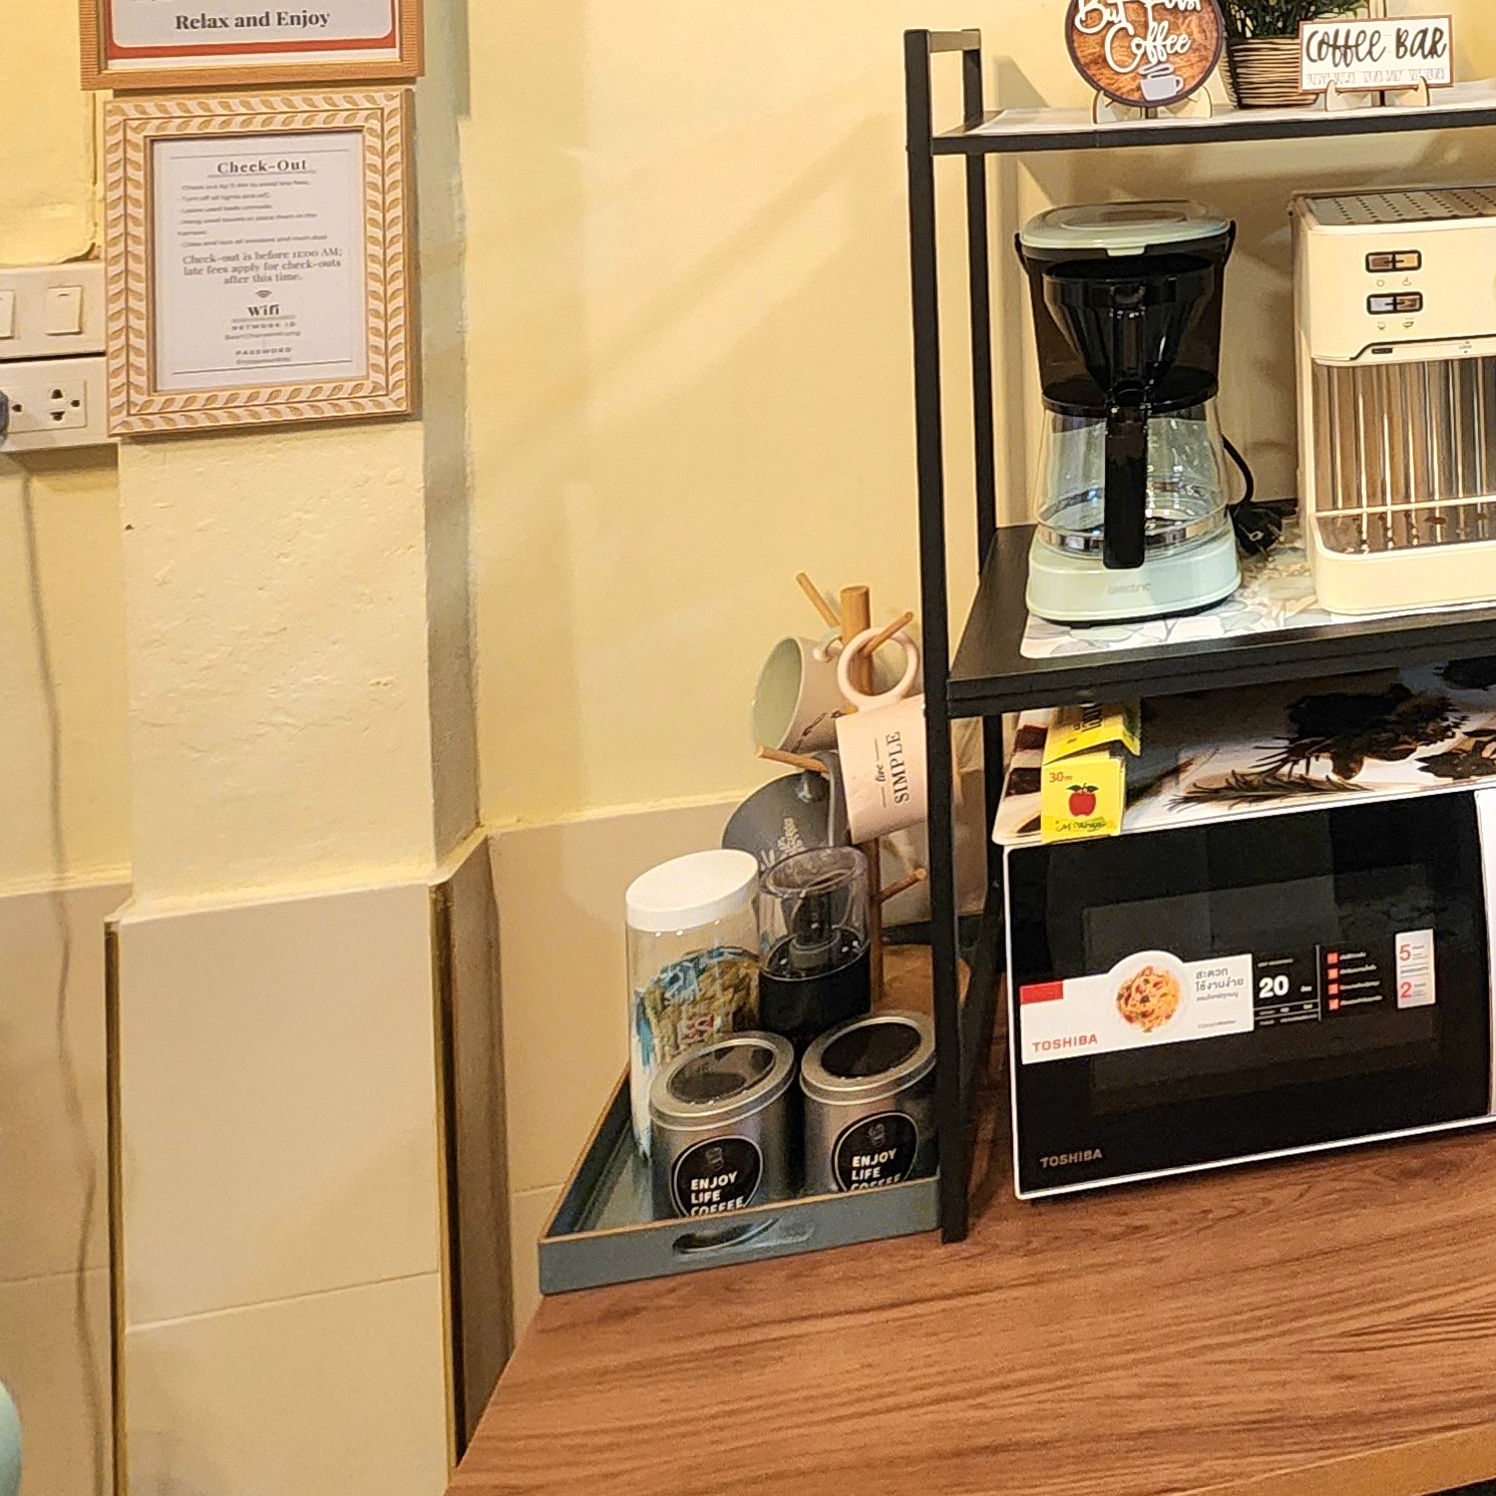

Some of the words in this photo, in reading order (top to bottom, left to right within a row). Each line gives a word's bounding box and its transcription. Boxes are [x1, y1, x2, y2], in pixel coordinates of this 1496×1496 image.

[175, 13, 230, 30] Relax
[234, 12, 270, 29] and
[277, 9, 331, 28] Enjoy
[1105, 21, 1192, 74] Coffee
[216, 159, 307, 175] Check-Out
[182, 252, 240, 264] Check-out
[255, 249, 290, 261] before
[183, 266, 204, 276] late
[206, 265, 228, 275] fees
[231, 263, 260, 274] apply
[263, 261, 280, 271] for
[282, 259, 342, 270] check-outs
[223, 276, 250, 285] after
[252, 274, 272, 283] this
[248, 303, 280, 316] Wifi
[885, 731, 910, 804] SIMPLE
[1399, 944, 1411, 962] 5
[1259, 975, 1290, 998] 20
[1400, 982, 1412, 998] 2
[1032, 1034, 1098, 1052] TOSHIBA
[852, 1148, 897, 1168] ENJOY
[1039, 1149, 1103, 1168] TOSHIBA
[691, 1171, 738, 1191] ENJOY
[851, 1167, 881, 1181] LIFE
[691, 1191, 721, 1204] LIFE
